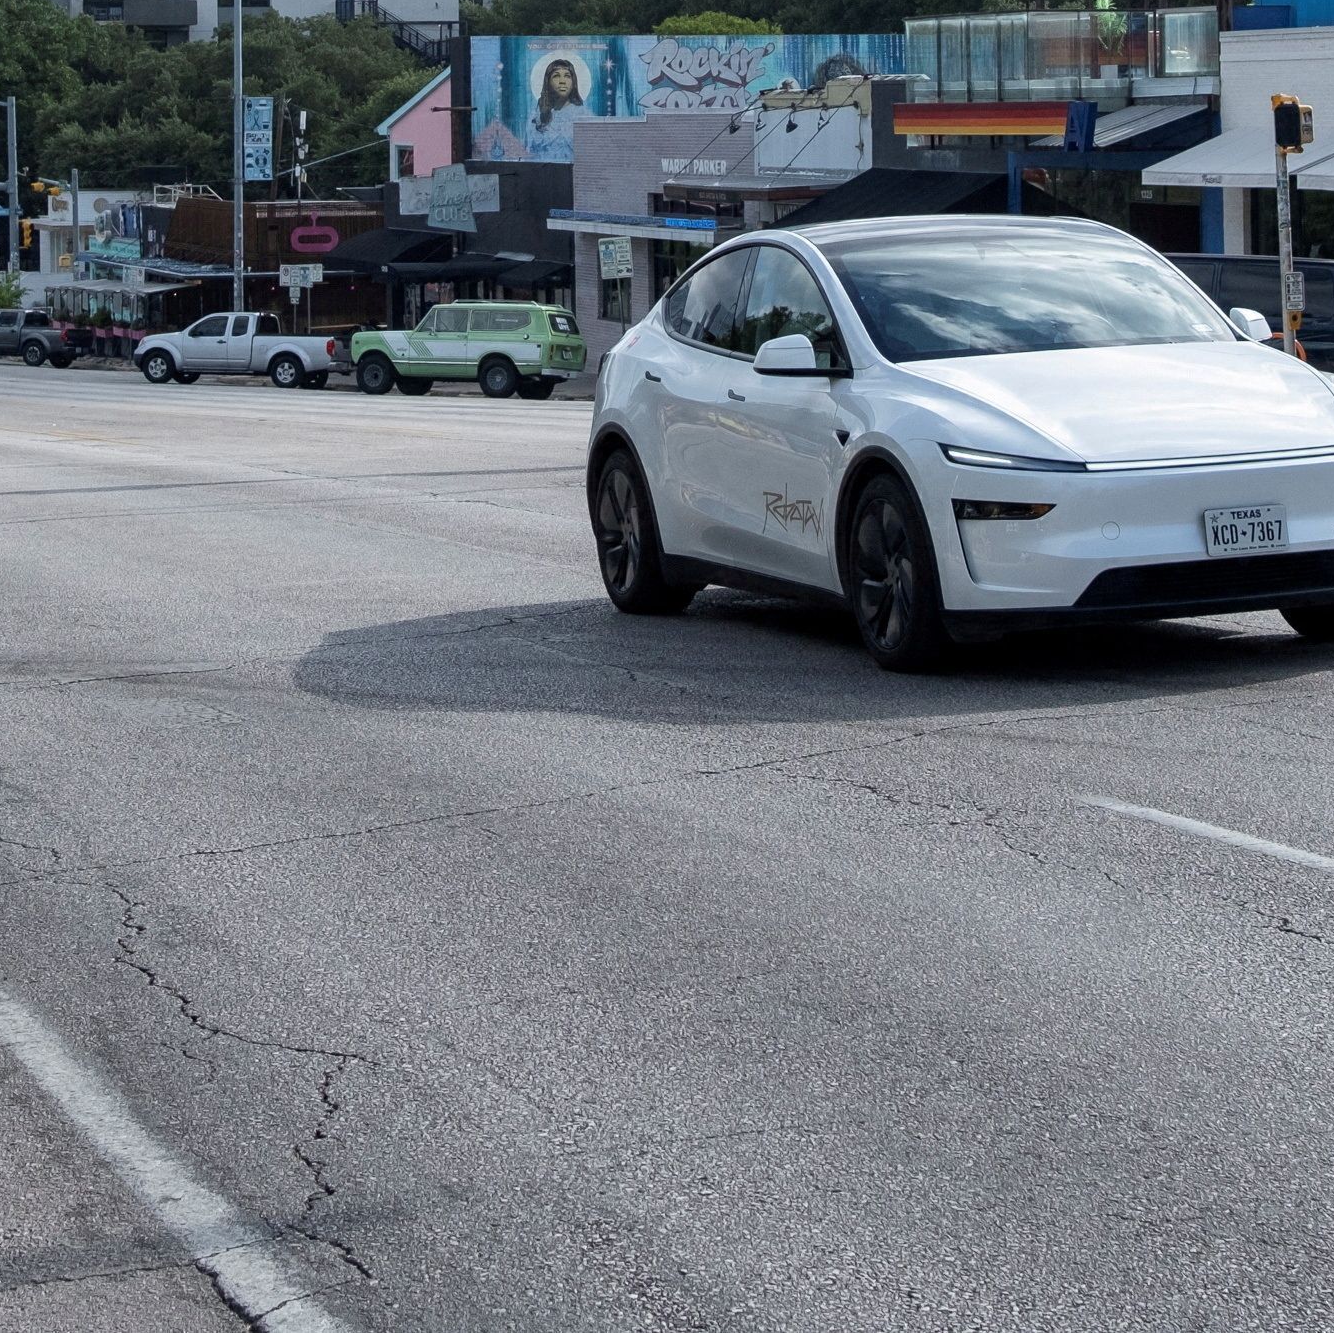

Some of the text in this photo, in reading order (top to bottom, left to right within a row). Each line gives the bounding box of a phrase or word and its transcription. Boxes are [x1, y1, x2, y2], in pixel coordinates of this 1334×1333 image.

[693, 158, 727, 176] PARKER
[1230, 509, 1262, 520] TEXAS
[1248, 520, 1283, 543] 7367
